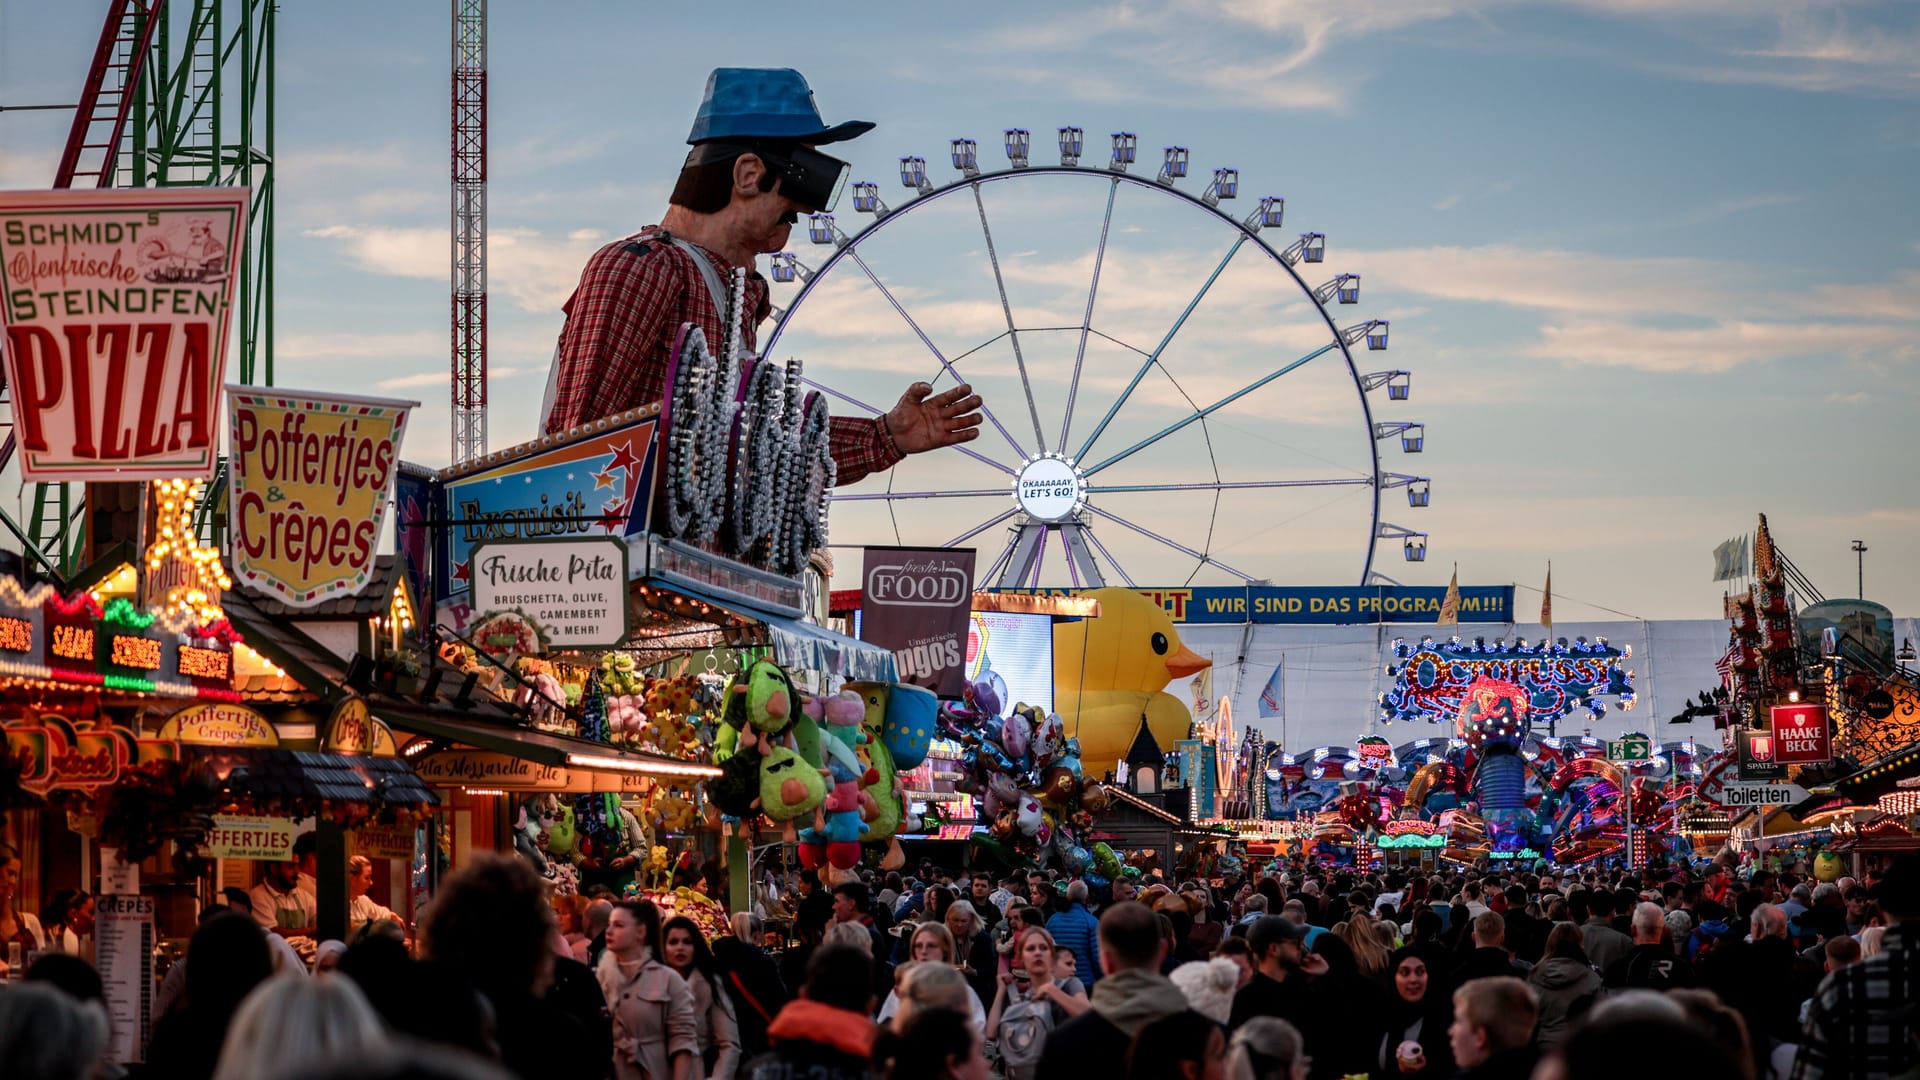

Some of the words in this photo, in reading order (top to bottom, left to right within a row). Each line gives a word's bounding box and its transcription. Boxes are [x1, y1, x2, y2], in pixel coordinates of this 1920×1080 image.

[8, 245, 140, 290] Ofenfrische
[7, 322, 210, 460] PIZZA
[237, 408, 394, 506] Poffertjes
[267, 486, 287, 501] &
[1024, 488, 1051, 498] LET'S
[1054, 487, 1074, 497] GO!
[461, 490, 592, 541] Exquisit
[238, 501, 376, 580] Crêpes
[481, 555, 563, 587] Frische
[567, 554, 617, 585] Pita
[876, 574, 960, 601] FOOD
[494, 593, 568, 605] BRUSCHETTA,
[572, 592, 608, 604] OLIVE,
[1206, 598, 1246, 613] WIR
[1255, 597, 1302, 613] SIND
[1310, 597, 1351, 613] DAS
[540, 609, 607, 620] CAMEMBERT
[552, 625, 560, 635] &
[564, 625, 600, 635] MEHR!
[909, 631, 958, 648] Ungarische
[893, 638, 961, 679] ngos
[177, 704, 267, 739] Poffertjes
[198, 725, 245, 741] Crêpes
[1780, 727, 1822, 741] HAAKE
[1785, 739, 1818, 753] BECK
[445, 756, 529, 779] Mozzarella
[1746, 762, 1779, 770] SPATEN
[1724, 787, 1791, 805] Toiletten
